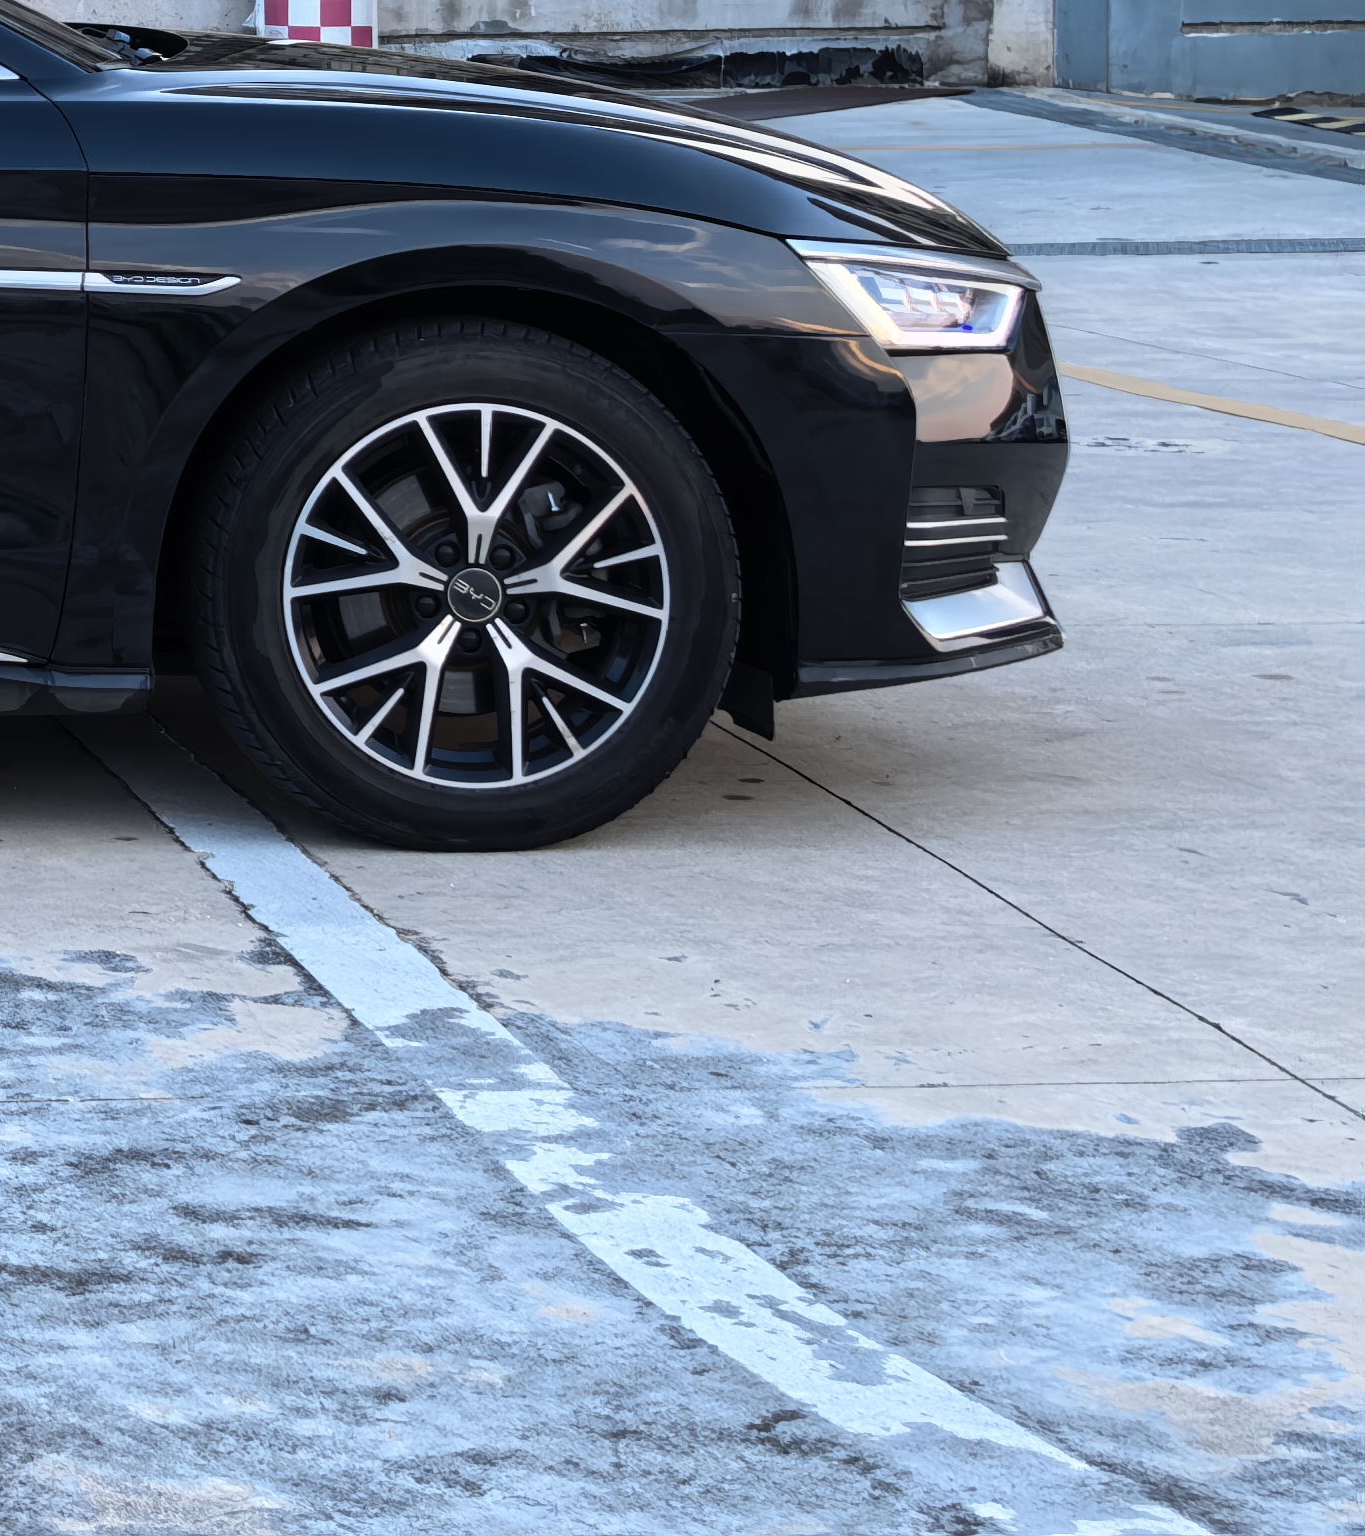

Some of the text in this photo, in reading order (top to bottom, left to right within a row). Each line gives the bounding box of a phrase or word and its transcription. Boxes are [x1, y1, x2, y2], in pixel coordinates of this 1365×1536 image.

[112, 275, 200, 284] BYD DESIGN
[453, 578, 497, 611] BYD
